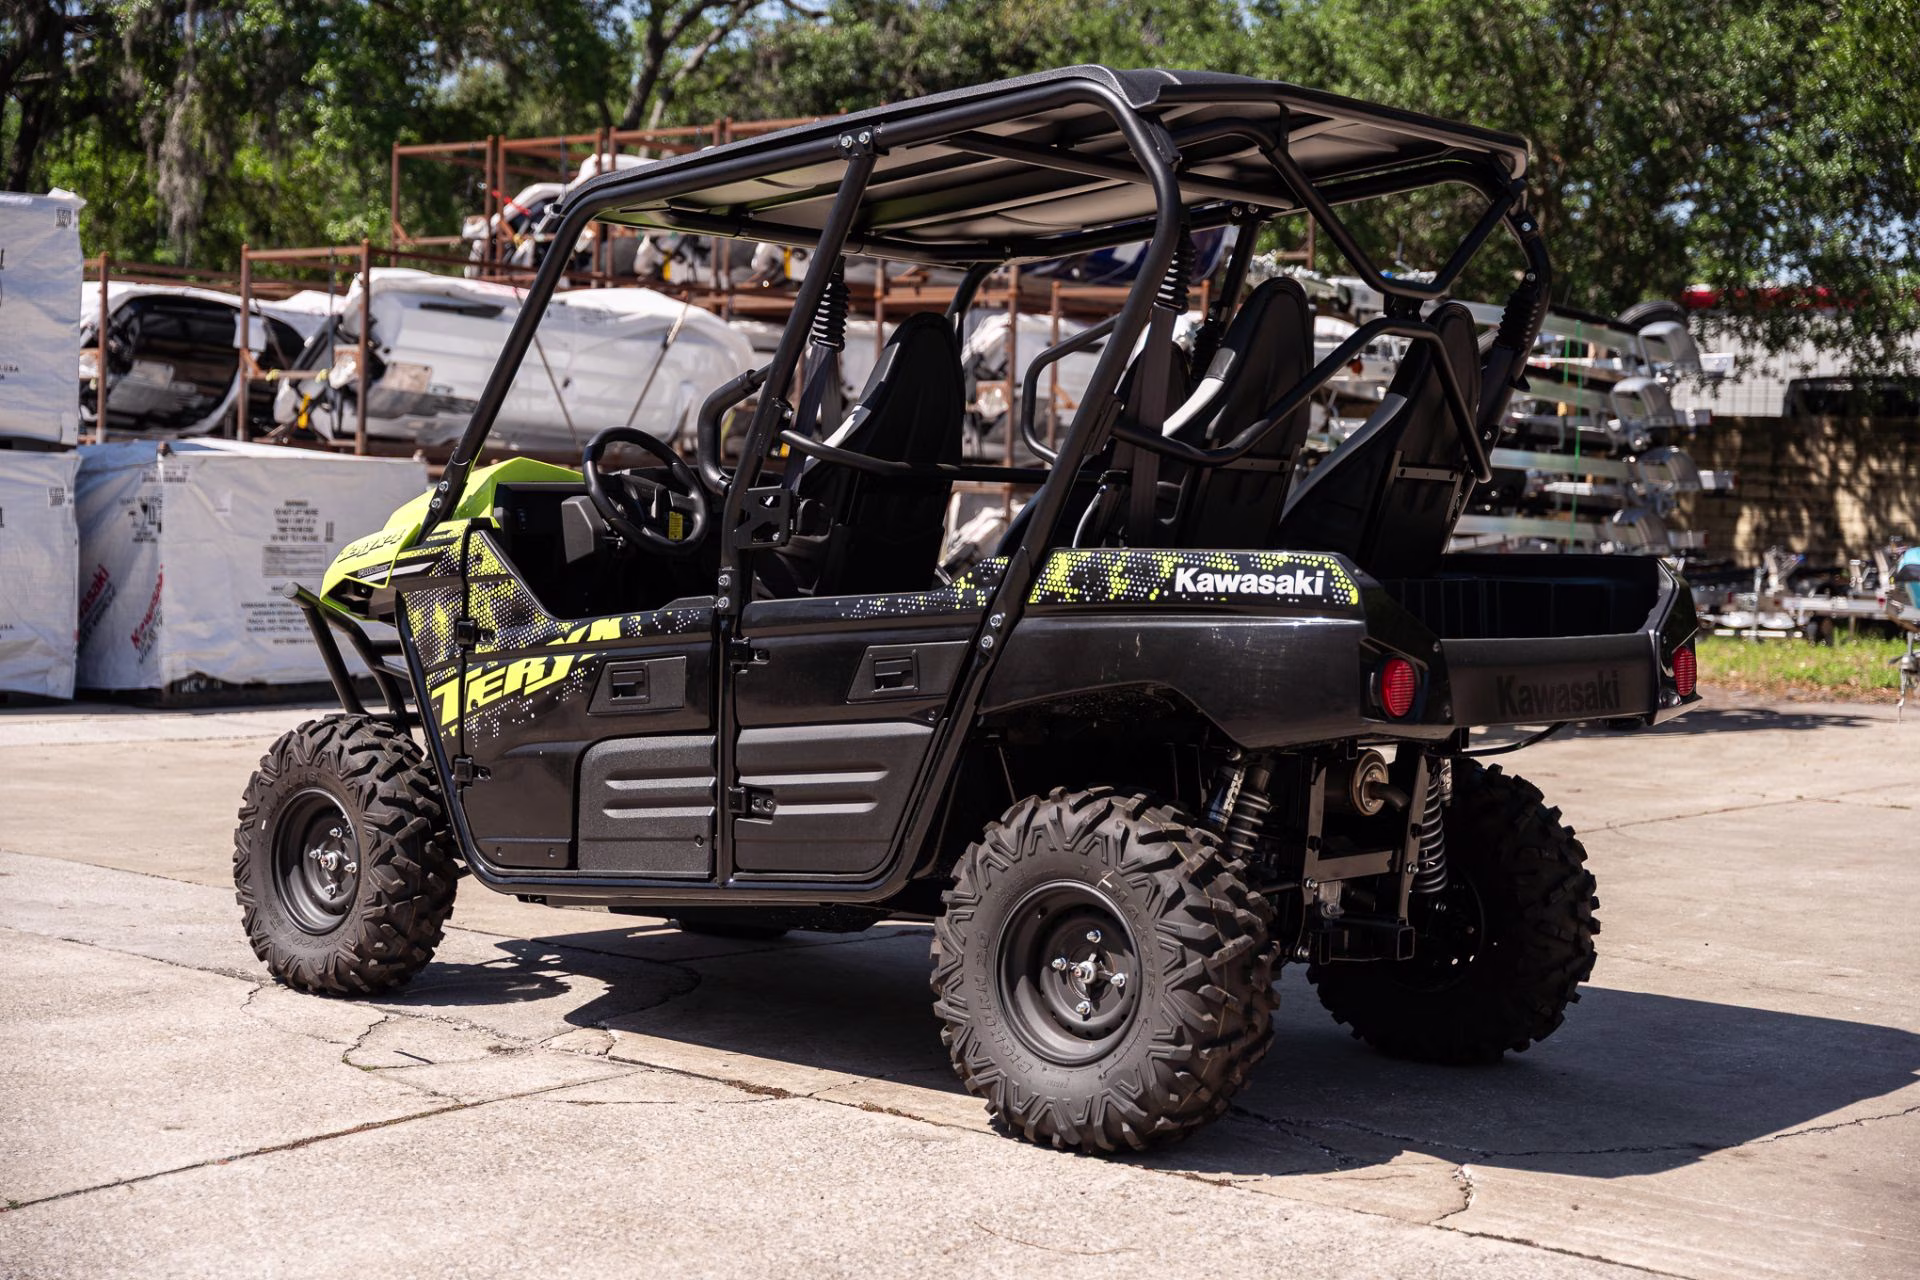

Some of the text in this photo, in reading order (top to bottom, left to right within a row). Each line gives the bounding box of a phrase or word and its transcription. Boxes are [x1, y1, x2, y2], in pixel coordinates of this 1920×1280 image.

[1174, 567, 1325, 596] Kawasaki
[431, 616, 623, 727] TERYX
[1497, 668, 1620, 717] Kawasaki
